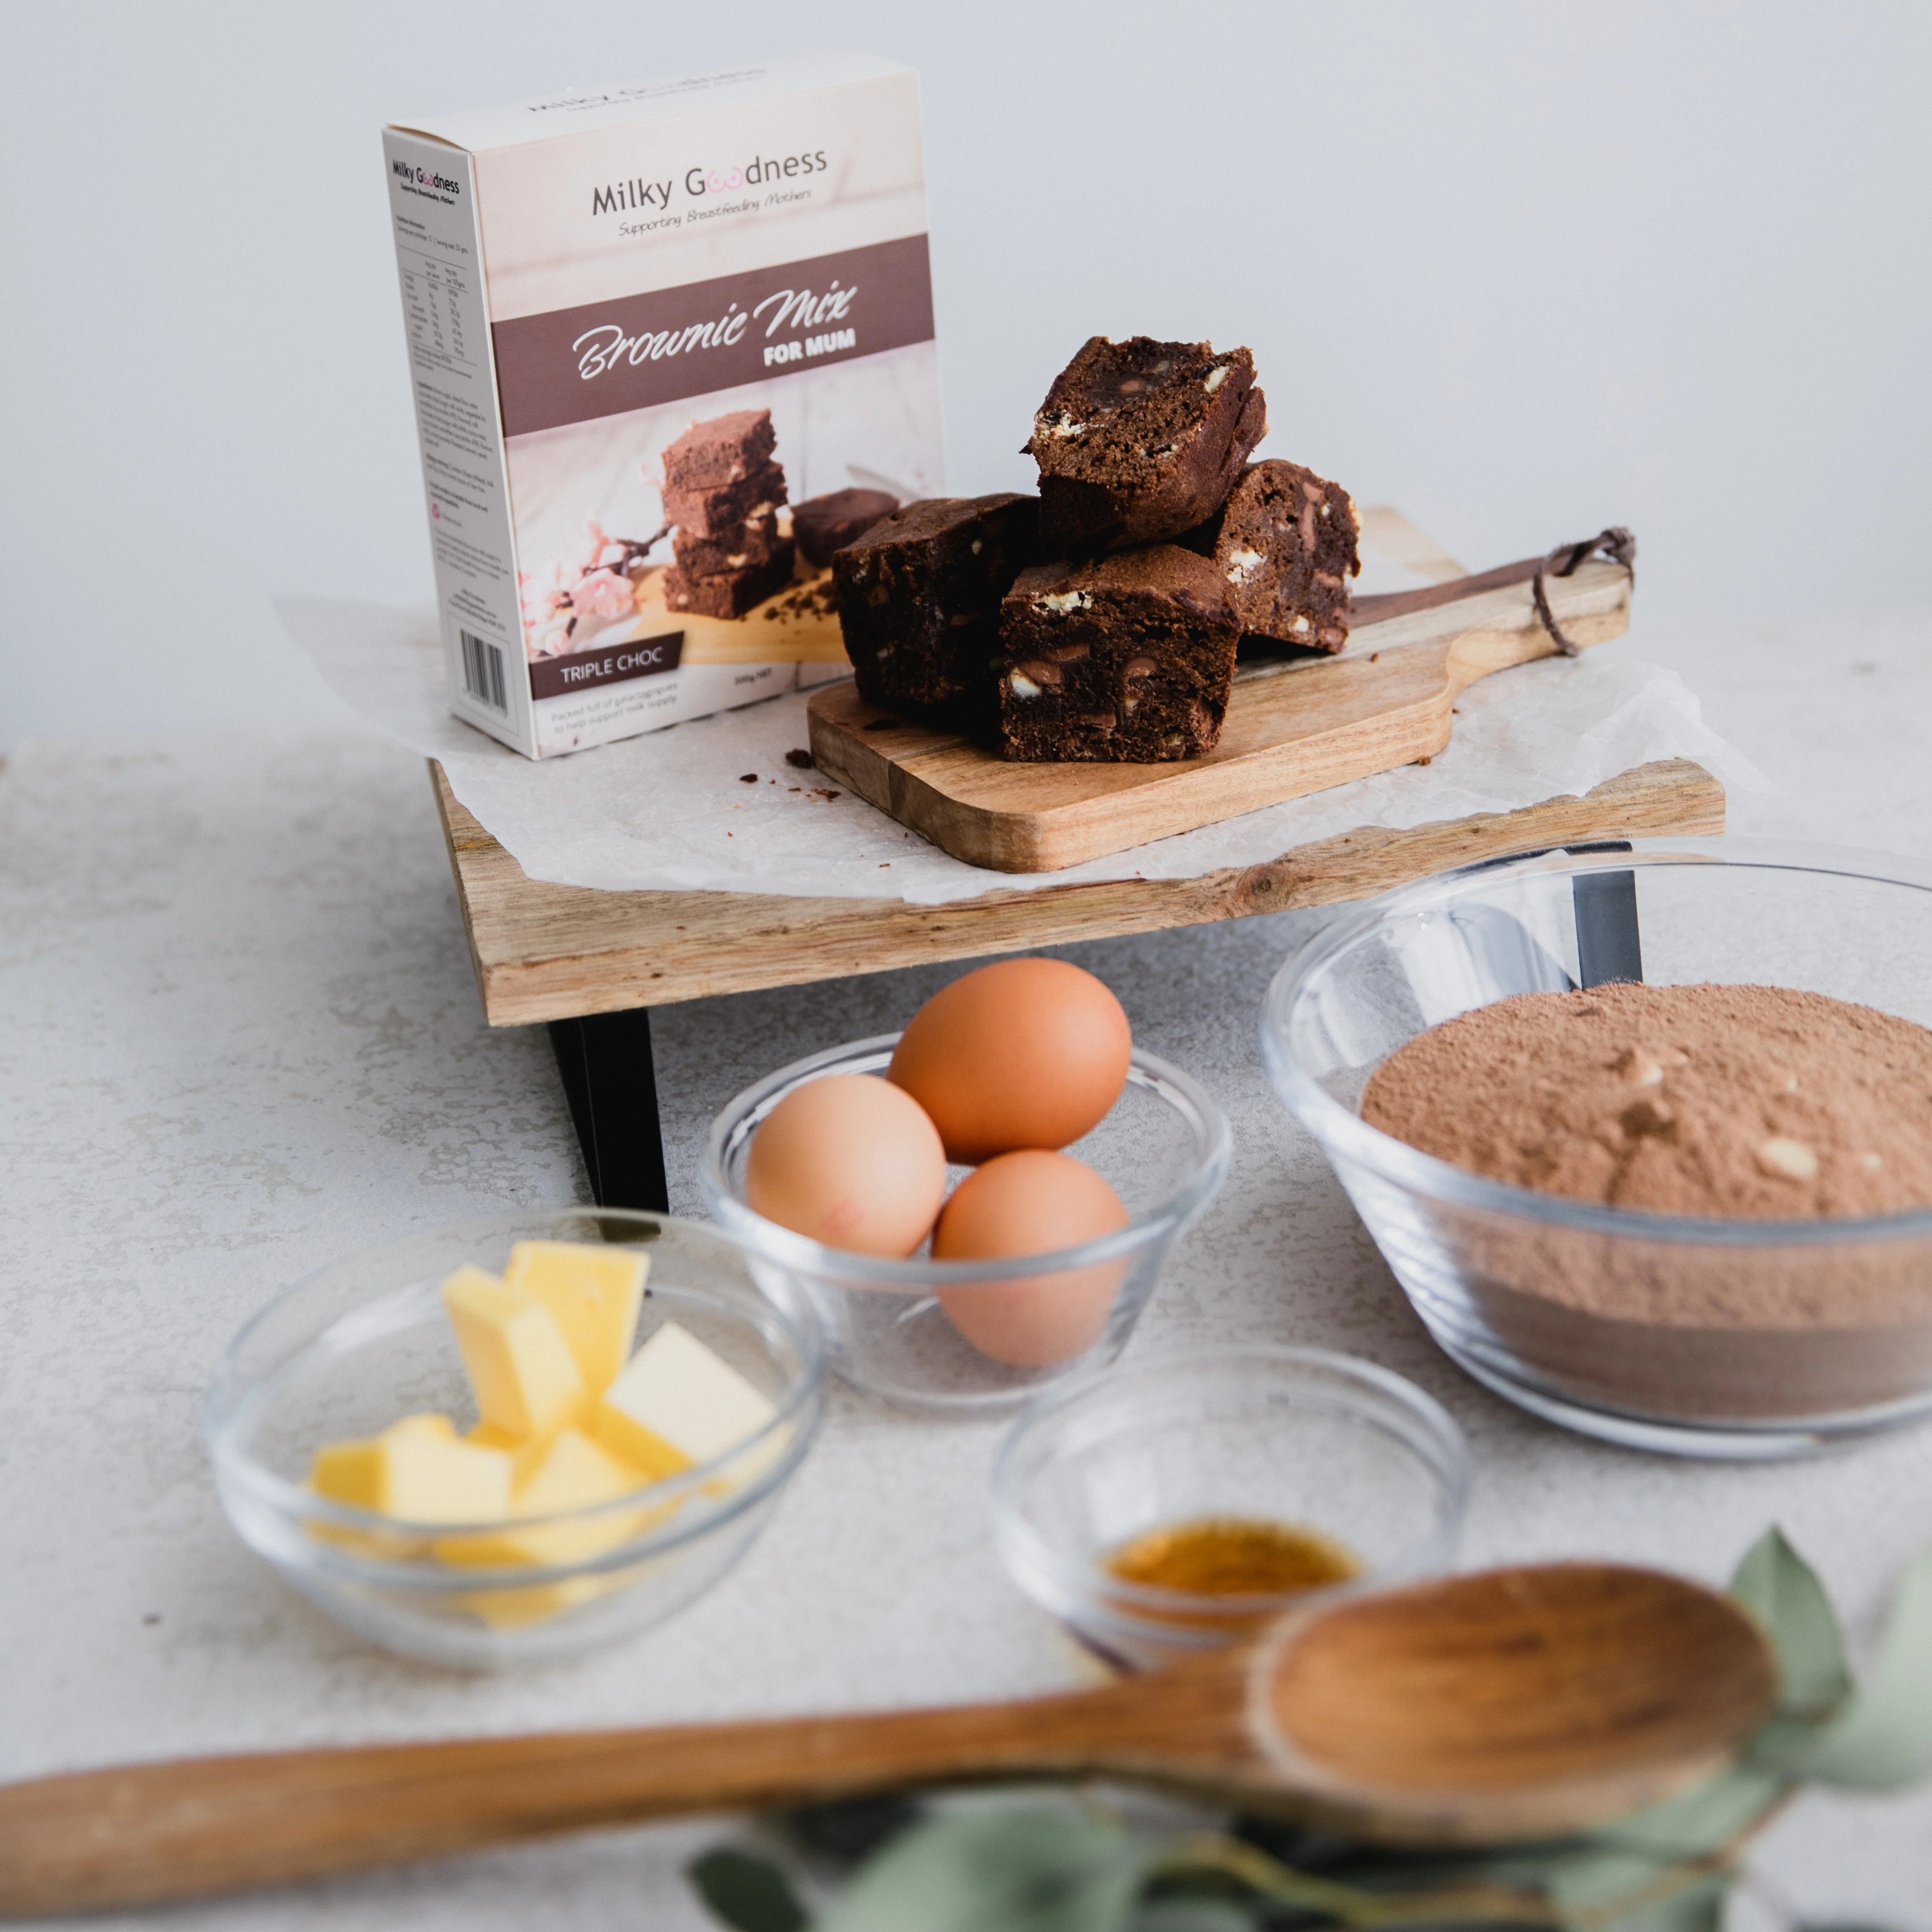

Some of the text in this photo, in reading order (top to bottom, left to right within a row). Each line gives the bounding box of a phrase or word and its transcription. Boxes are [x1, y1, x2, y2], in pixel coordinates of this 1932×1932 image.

[393, 159, 414, 184] Milky
[592, 178, 672, 215] Milky
[618, 188, 812, 236] Supporting Breastfeeding Mothers
[572, 280, 859, 379] Brownie Mix
[764, 328, 856, 366] FOR MUM
[560, 646, 663, 683] TRIPLE CHOC
[551, 707, 584, 722] Packed
[586, 701, 600, 713] full
[603, 700, 613, 708] of
[566, 719, 586, 732] help
[588, 707, 624, 724] support
[626, 702, 645, 715] milk
